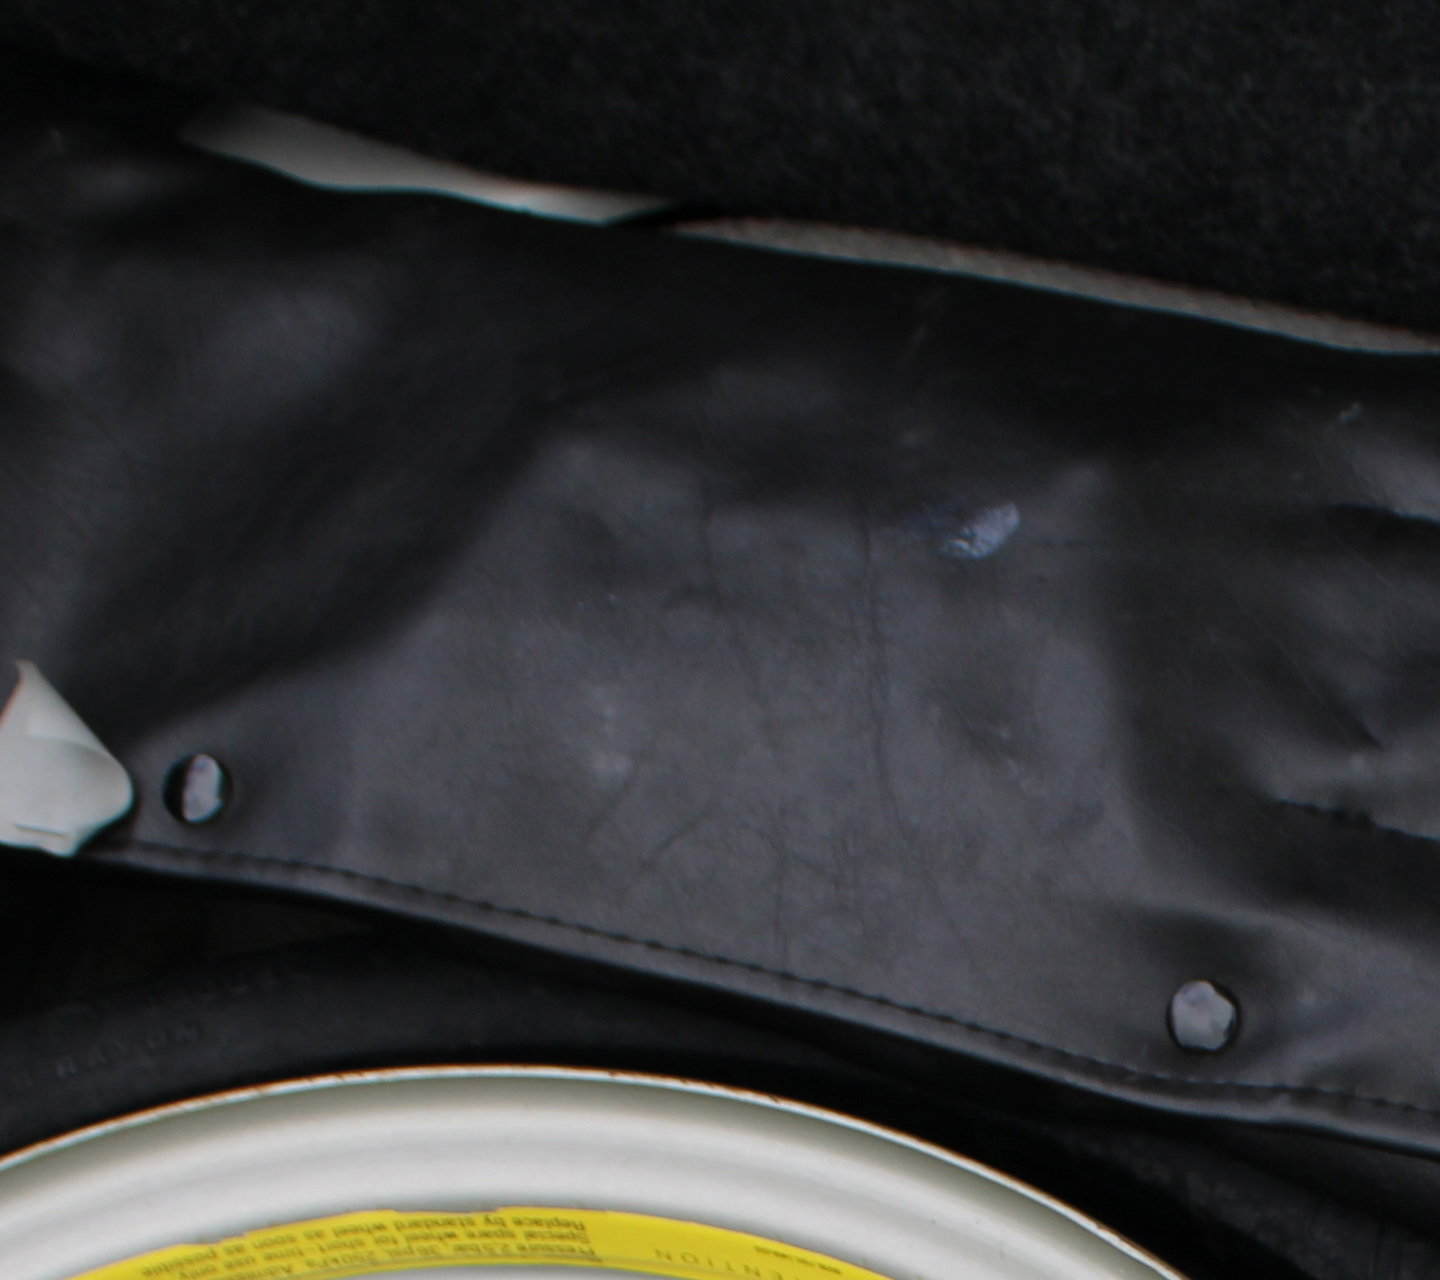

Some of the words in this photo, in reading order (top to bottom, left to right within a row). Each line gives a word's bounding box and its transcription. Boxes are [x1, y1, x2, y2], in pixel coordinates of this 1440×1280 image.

[394, 1215, 477, 1233] standard
[480, 1213, 509, 1228] by
[510, 1214, 589, 1232] Replace
[302, 1227, 326, 1243] as
[332, 1220, 388, 1240] wheel
[404, 1229, 460, 1246] wheel
[464, 1227, 519, 1242] spare
[521, 1229, 593, 1245] Special
[222, 1241, 246, 1258] as
[251, 1231, 297, 1252] soon
[223, 1253, 257, 1273] use
